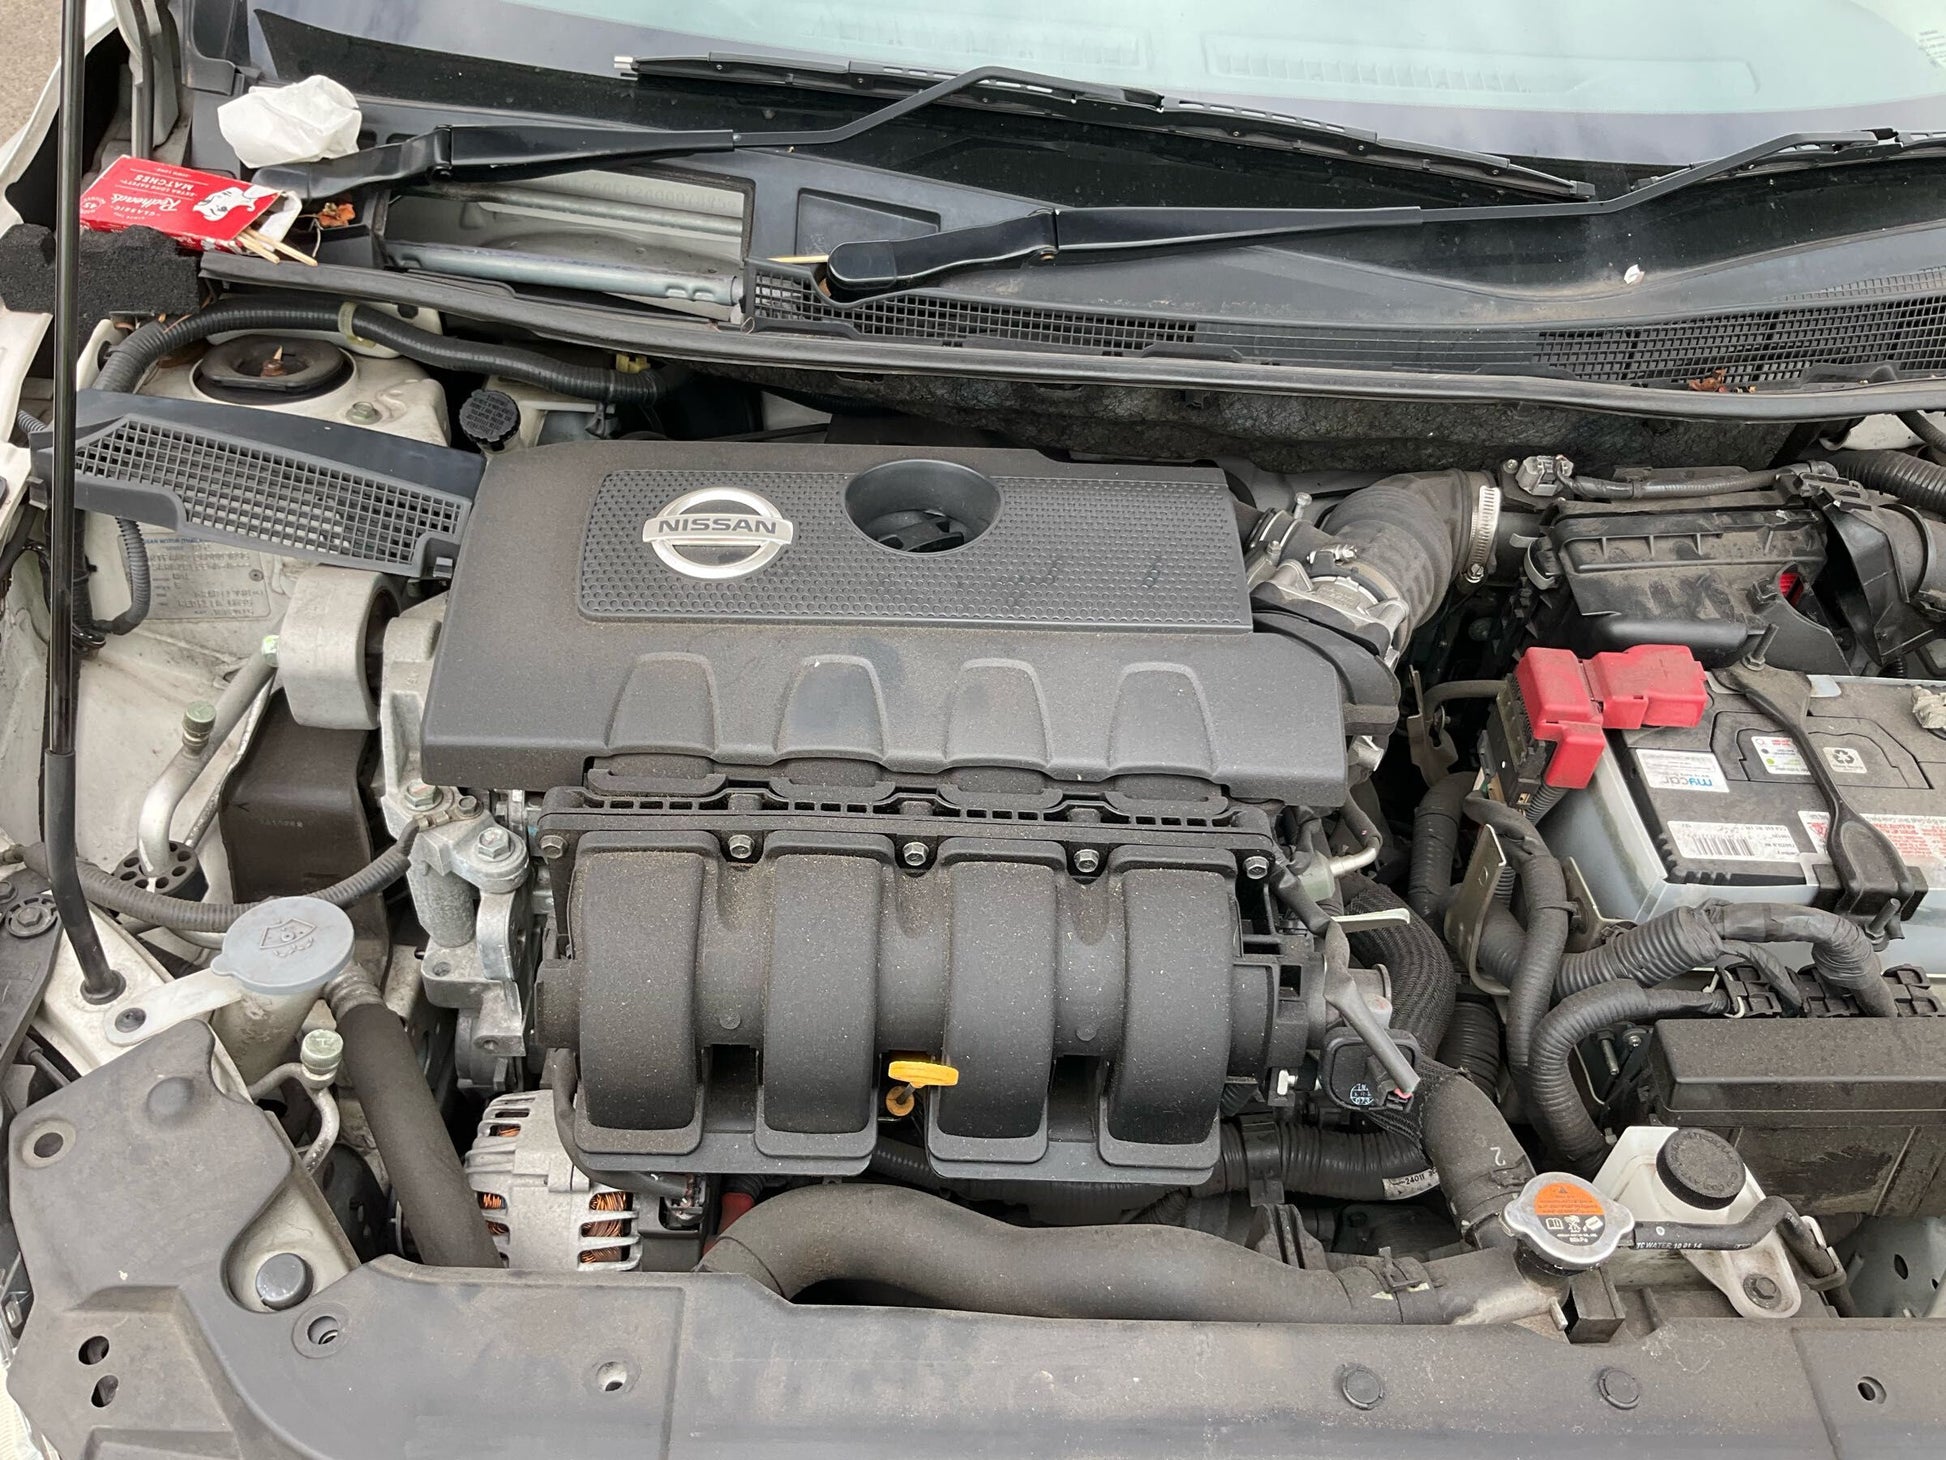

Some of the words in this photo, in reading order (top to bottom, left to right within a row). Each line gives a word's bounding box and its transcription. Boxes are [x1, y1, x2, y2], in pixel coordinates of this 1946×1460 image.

[134, 174, 194, 191] MATCHES
[171, 188, 195, 197] EXTRA
[111, 193, 182, 212] Redheads
[658, 518, 777, 535] NISSAN
[1663, 776, 1713, 787] mycar
[1646, 1241, 1673, 1249] WATER
